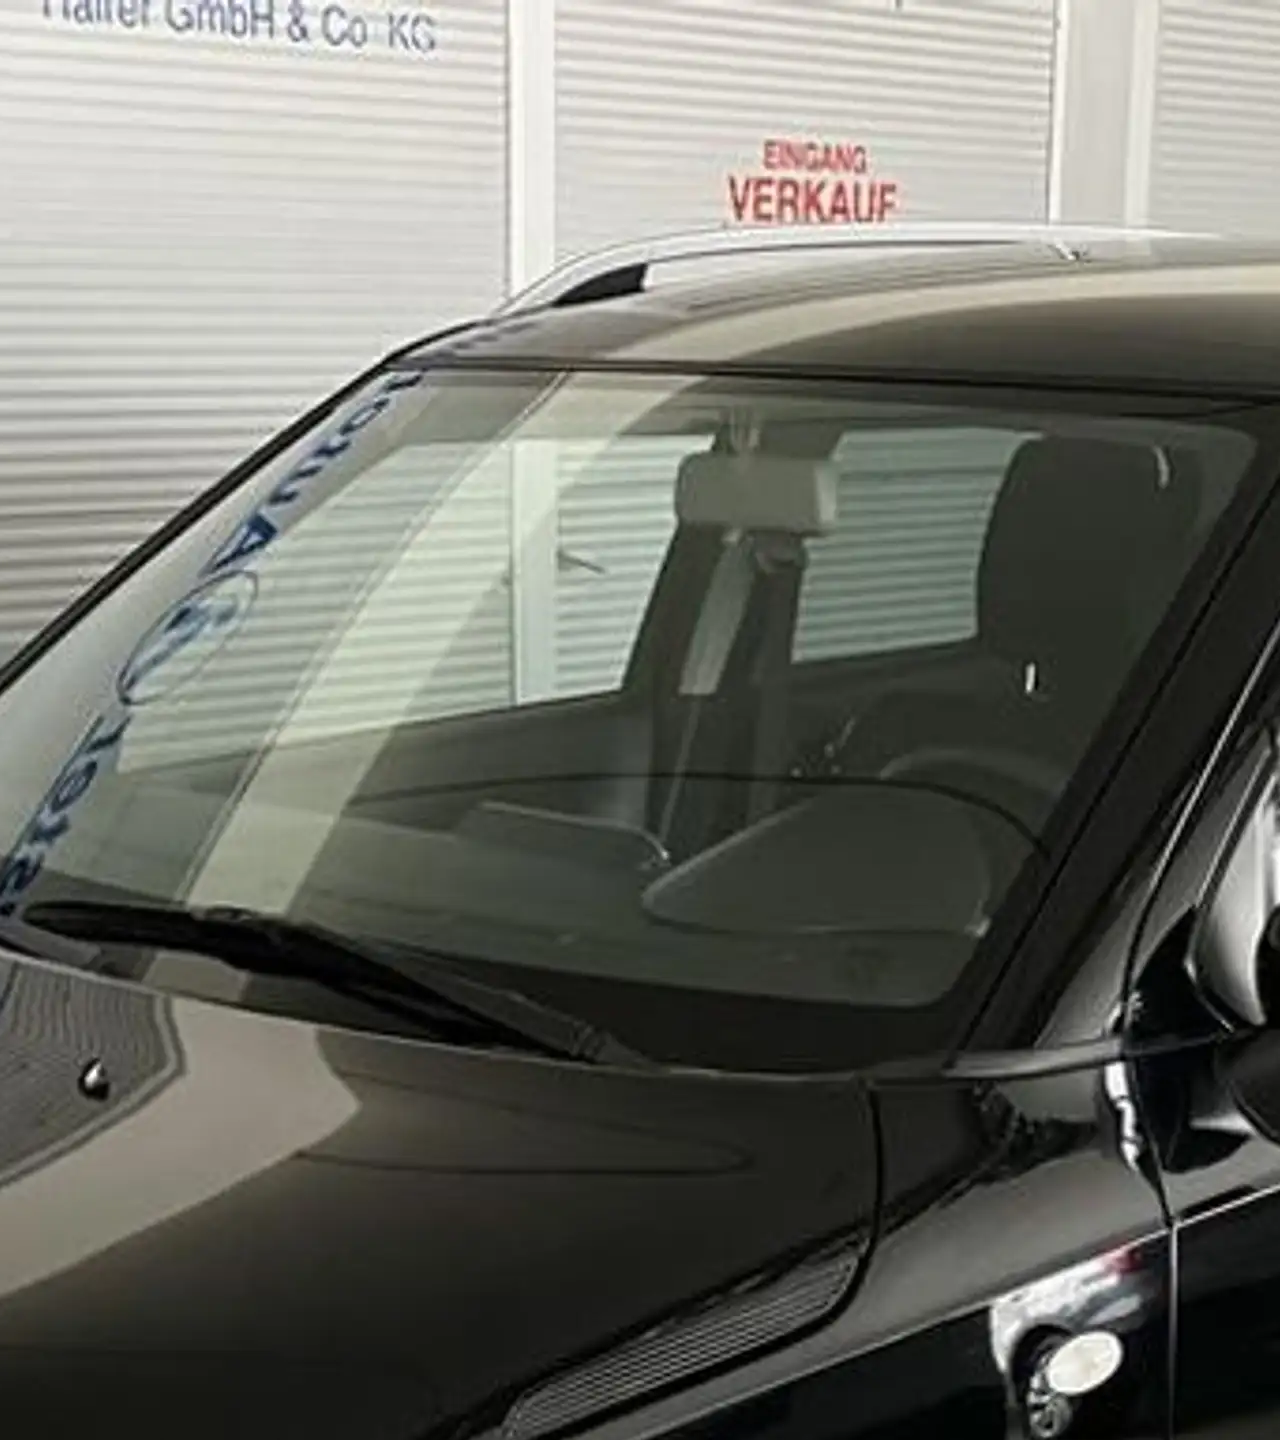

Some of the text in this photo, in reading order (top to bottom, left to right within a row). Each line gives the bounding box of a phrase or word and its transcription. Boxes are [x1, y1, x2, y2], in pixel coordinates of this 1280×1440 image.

[165, 0, 274, 40] GmbH
[287, 0, 309, 43] &
[389, 12, 436, 52] KG
[763, 140, 867, 173] EINGANG
[728, 175, 897, 223] VERKAUF
